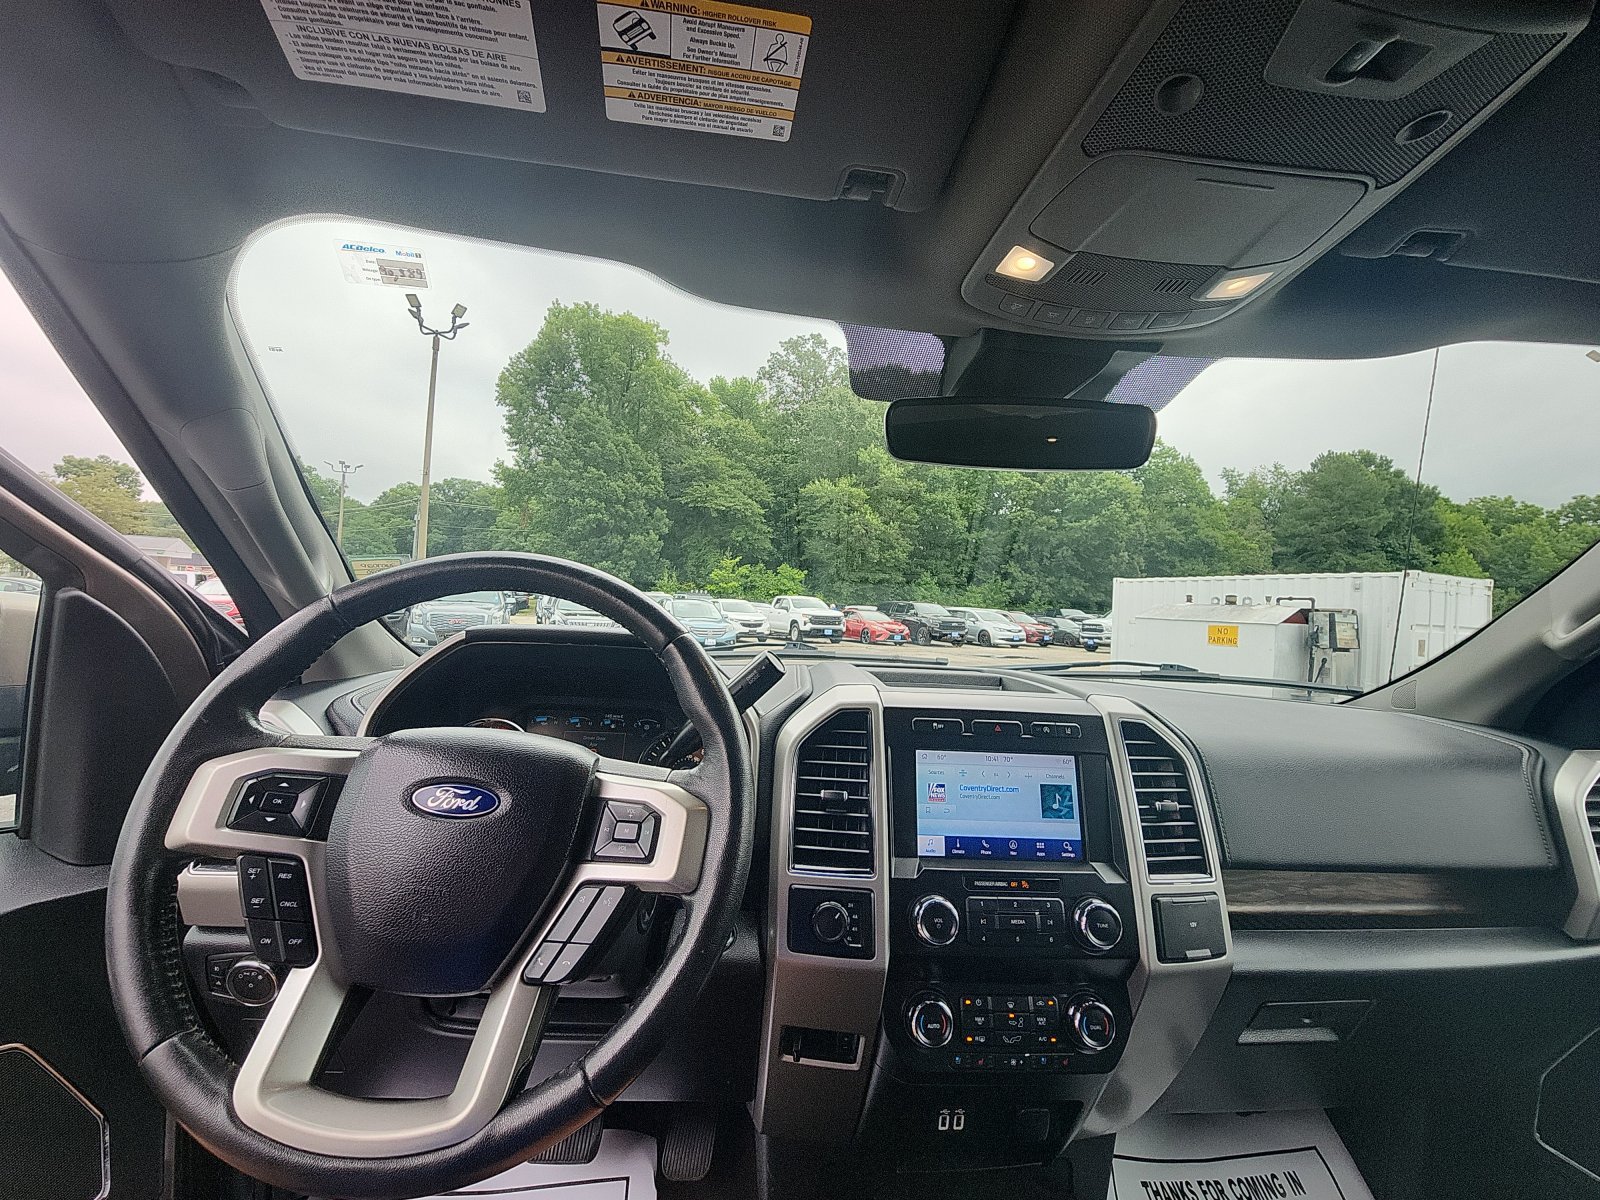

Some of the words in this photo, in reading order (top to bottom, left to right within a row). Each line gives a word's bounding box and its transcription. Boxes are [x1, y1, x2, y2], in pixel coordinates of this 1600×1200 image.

[651, 0, 700, 14] WARNING:
[702, 10, 728, 20] HIGHER
[728, 14, 762, 25] ROLLOVER
[683, 16, 697, 25] Avoid
[698, 19, 715, 28] Abrupt
[716, 22, 745, 33] Maneuvers
[295, 23, 347, 38] INCLUSIVE
[348, 31, 369, 41] CON
[371, 34, 390, 44] LAS
[392, 38, 430, 50] NUEVAS
[432, 44, 469, 56] BOLSAS
[471, 49, 484, 58] DE
[485, 51, 507, 61] AIRE
[690, 36, 708, 44] Always
[709, 39, 726, 47] Buckle
[711, 56, 740, 66] Information
[625, 55, 706, 74] AVERTISSEMENT:
[707, 68, 729, 78] RISQUE
[730, 71, 750, 81] ACCRU
[760, 76, 792, 87] CAPOTAGE
[637, 92, 701, 106] ADVERTENCIA:
[342, 243, 386, 254] ACDelco
[1208, 636, 1238, 645] PARKING
[960, 784, 1019, 793] CoventryDirect.com
[427, 787, 482, 811] Ford
[1140, 1181, 1199, 1200] THANKS
[1194, 1178, 1228, 1200] FOR
[1227, 1172, 1288, 1199] COMING
[1284, 1170, 1307, 1196] IN
